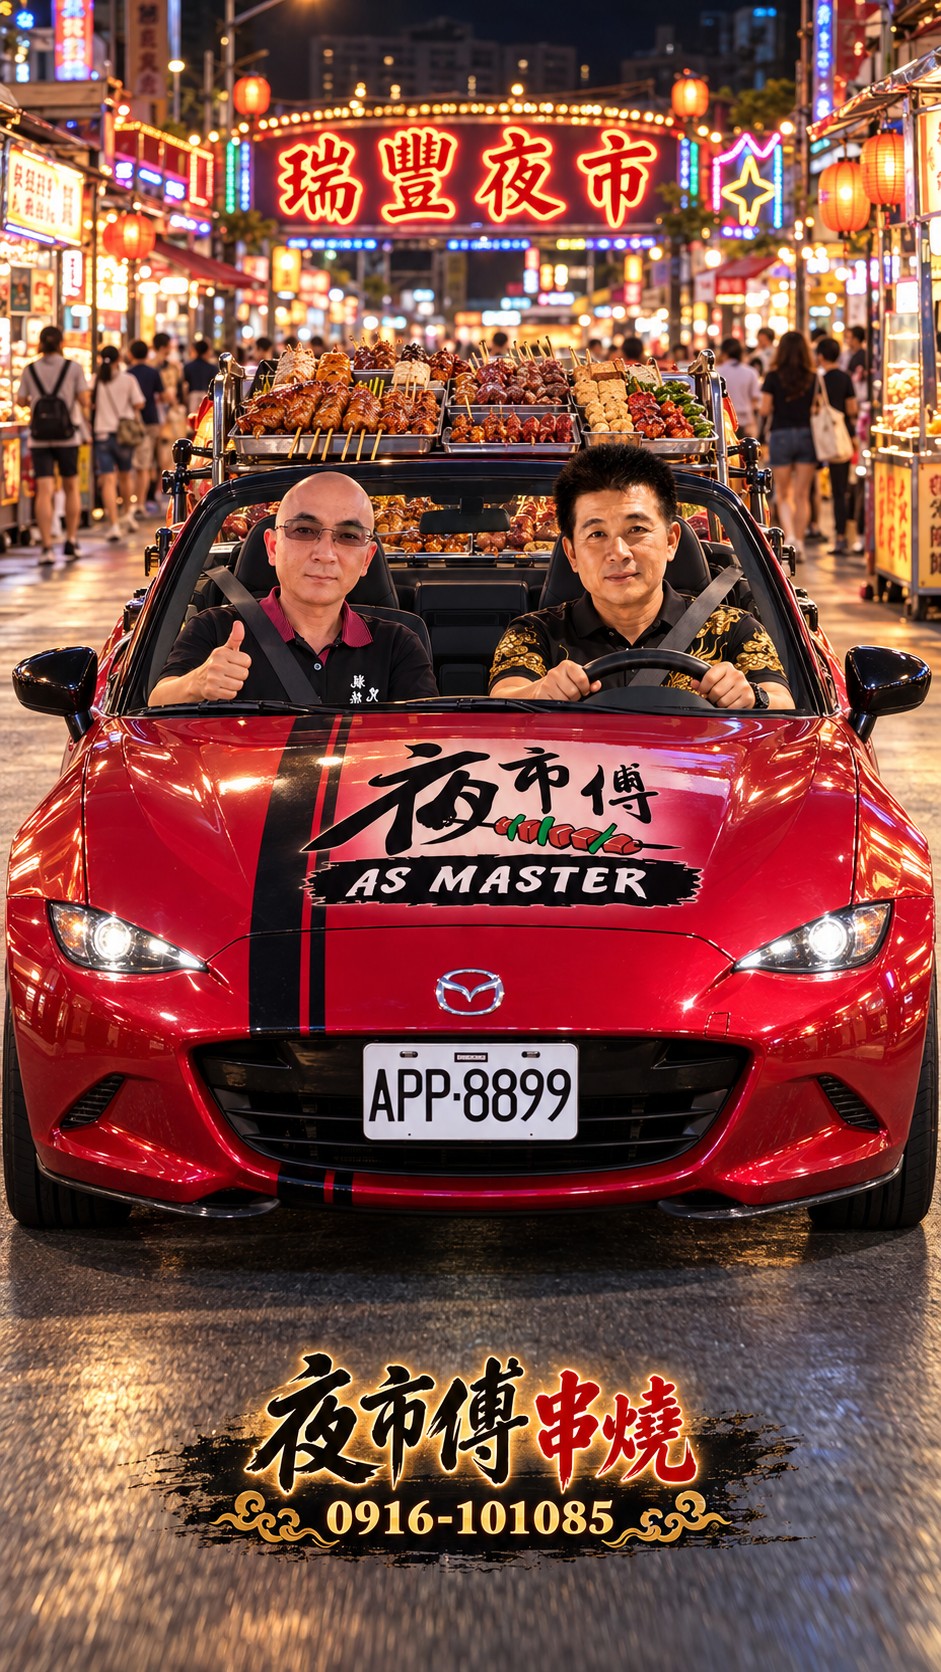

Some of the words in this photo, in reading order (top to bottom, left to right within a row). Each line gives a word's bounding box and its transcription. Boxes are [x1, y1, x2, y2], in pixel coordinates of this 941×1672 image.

[278, 126, 658, 229] 瑞豐夜市
[345, 866, 412, 898] AS
[428, 865, 648, 900] MASTER
